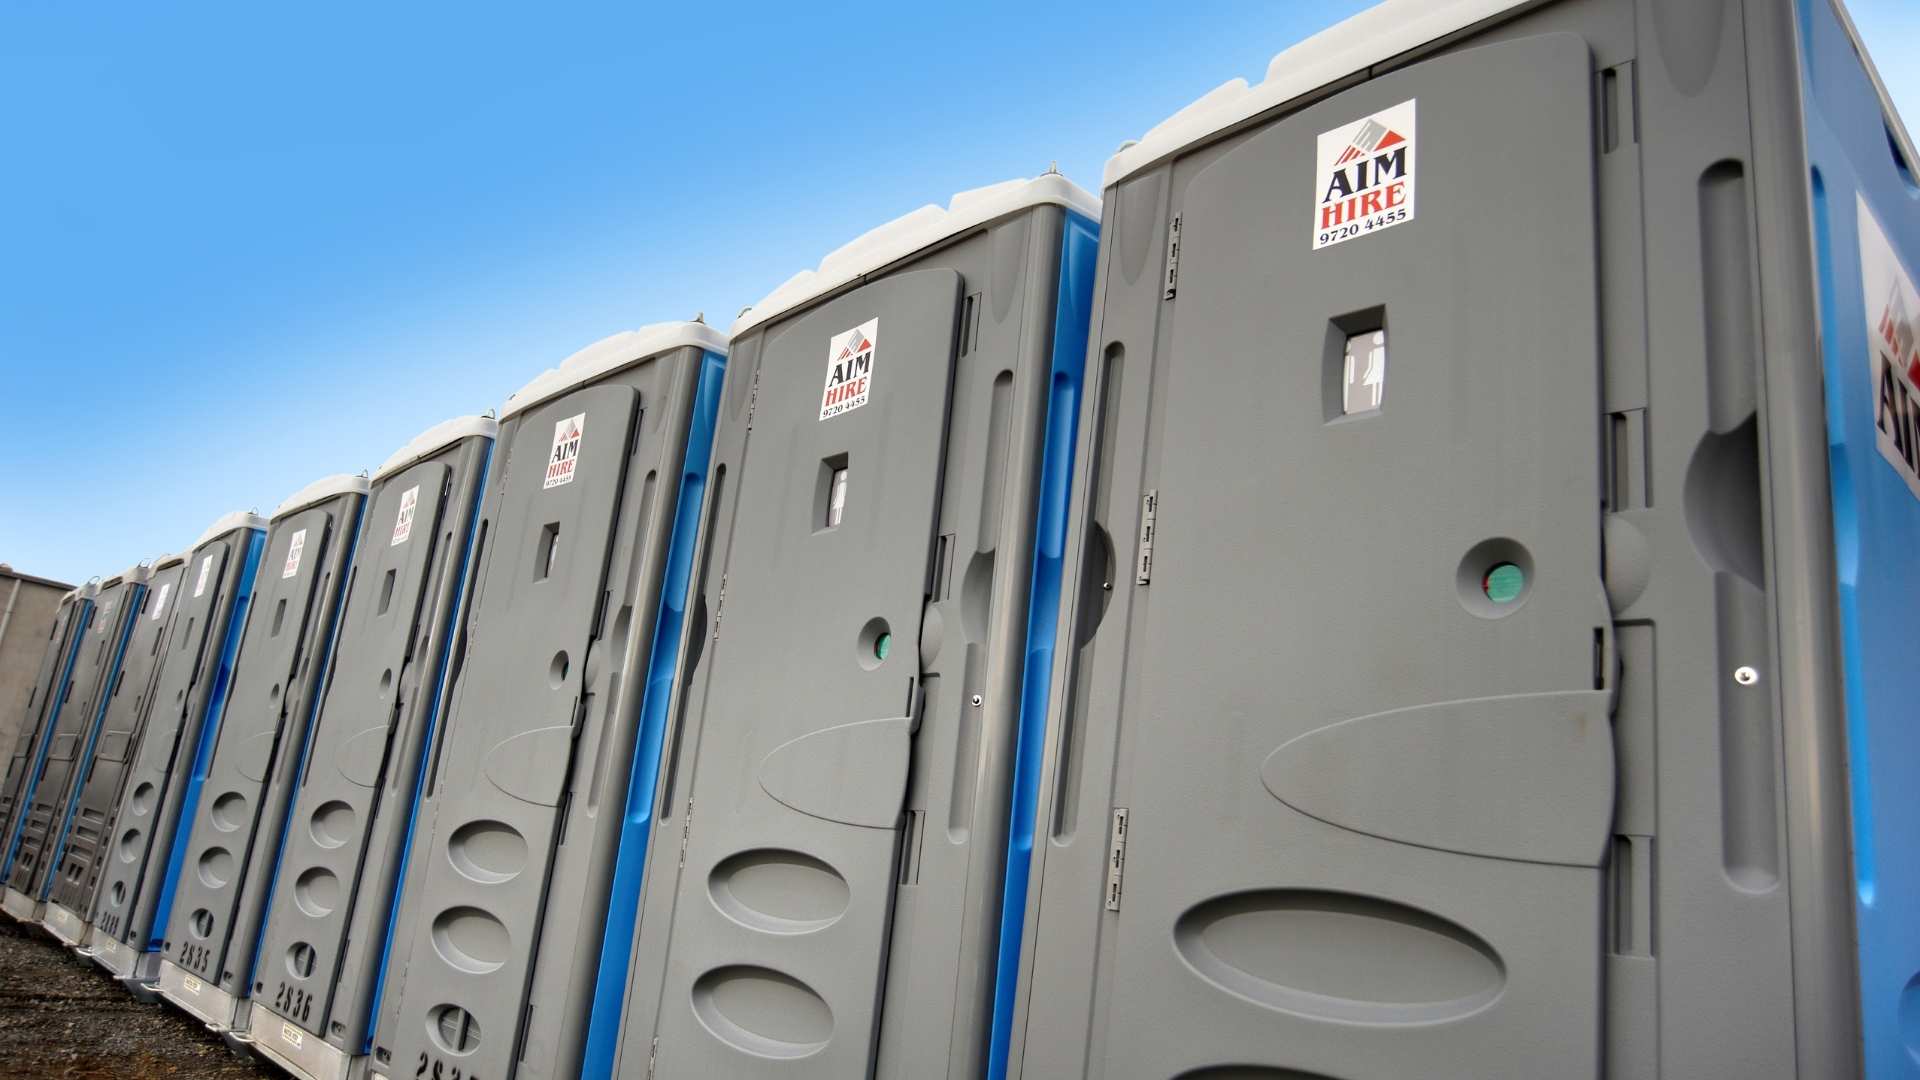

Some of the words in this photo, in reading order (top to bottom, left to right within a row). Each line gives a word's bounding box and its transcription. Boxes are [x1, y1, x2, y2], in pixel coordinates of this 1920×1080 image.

[1321, 145, 1408, 204] AIM
[1320, 181, 1408, 230] HIRE
[1319, 223, 1359, 245] 9720
[1364, 208, 1407, 230] 4455
[828, 350, 872, 388] AIM
[823, 404, 843, 418] 9720
[845, 395, 865, 409] 4455
[825, 376, 868, 407] HIRE
[551, 438, 579, 464] AIM
[547, 458, 575, 479] HIRE
